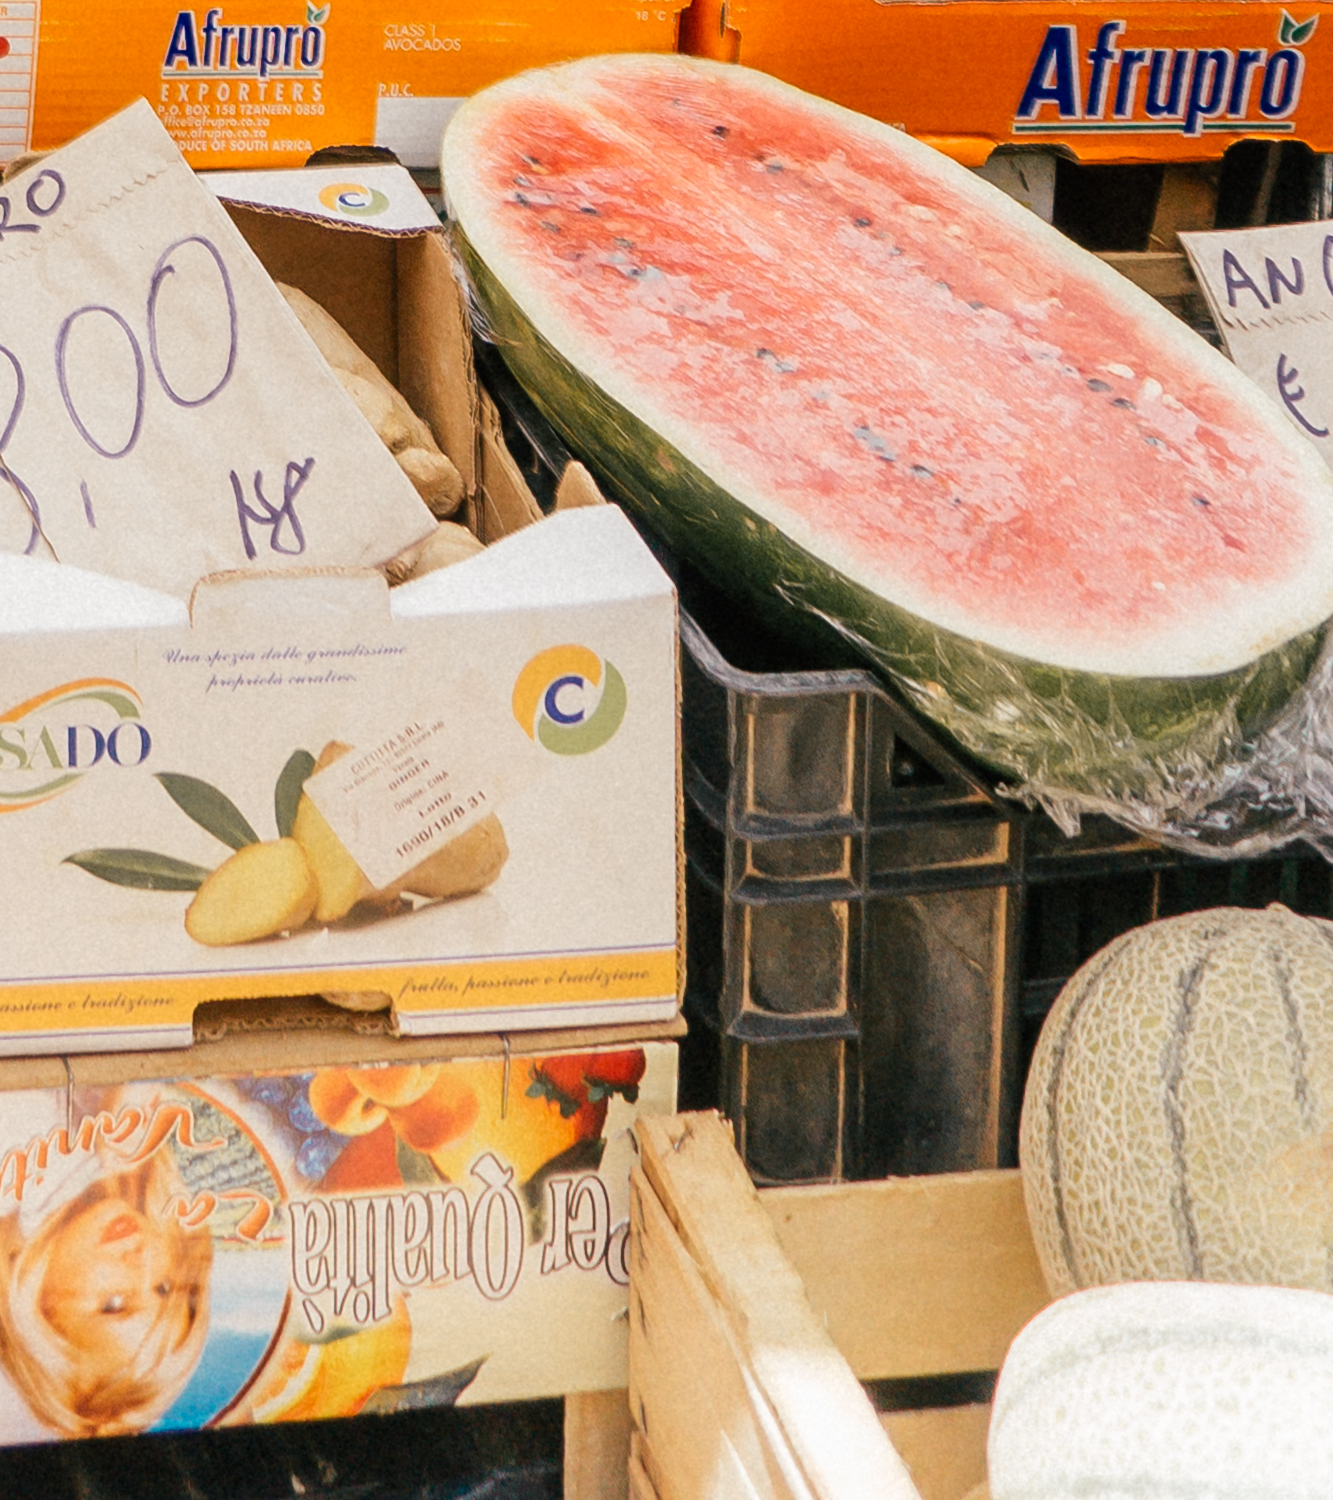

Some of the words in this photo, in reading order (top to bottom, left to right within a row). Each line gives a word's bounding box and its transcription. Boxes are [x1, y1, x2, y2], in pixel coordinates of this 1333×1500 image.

[383, 24, 425, 38] CLASS
[162, 7, 327, 81] Afrupro
[383, 38, 463, 52] AVOCADOS
[377, 82, 415, 98] P.U.C.
[1012, 19, 1307, 138] Afrupro
[160, 82, 324, 103] EXPORTERS
[185, 104, 209, 116] BOX
[214, 104, 237, 116] 158
[240, 104, 292, 116] TZANEEN
[294, 104, 326, 116] 0850
[229, 139, 268, 152] SOUTH
[271, 139, 313, 152] AFRICA
[1223, 247, 1333, 311] AN
[162, 648, 200, 665] Una
[205, 647, 256, 671] spezia
[260, 646, 303, 663] dalle
[205, 672, 284, 696] proprietà
[397, 974, 460, 999] frutta,
[464, 974, 538, 998] passione
[559, 967, 652, 990] tradizione
[81, 994, 176, 1015] tradizione
[162, 1188, 273, 1245] La
[290, 1154, 527, 1333] Qualità
